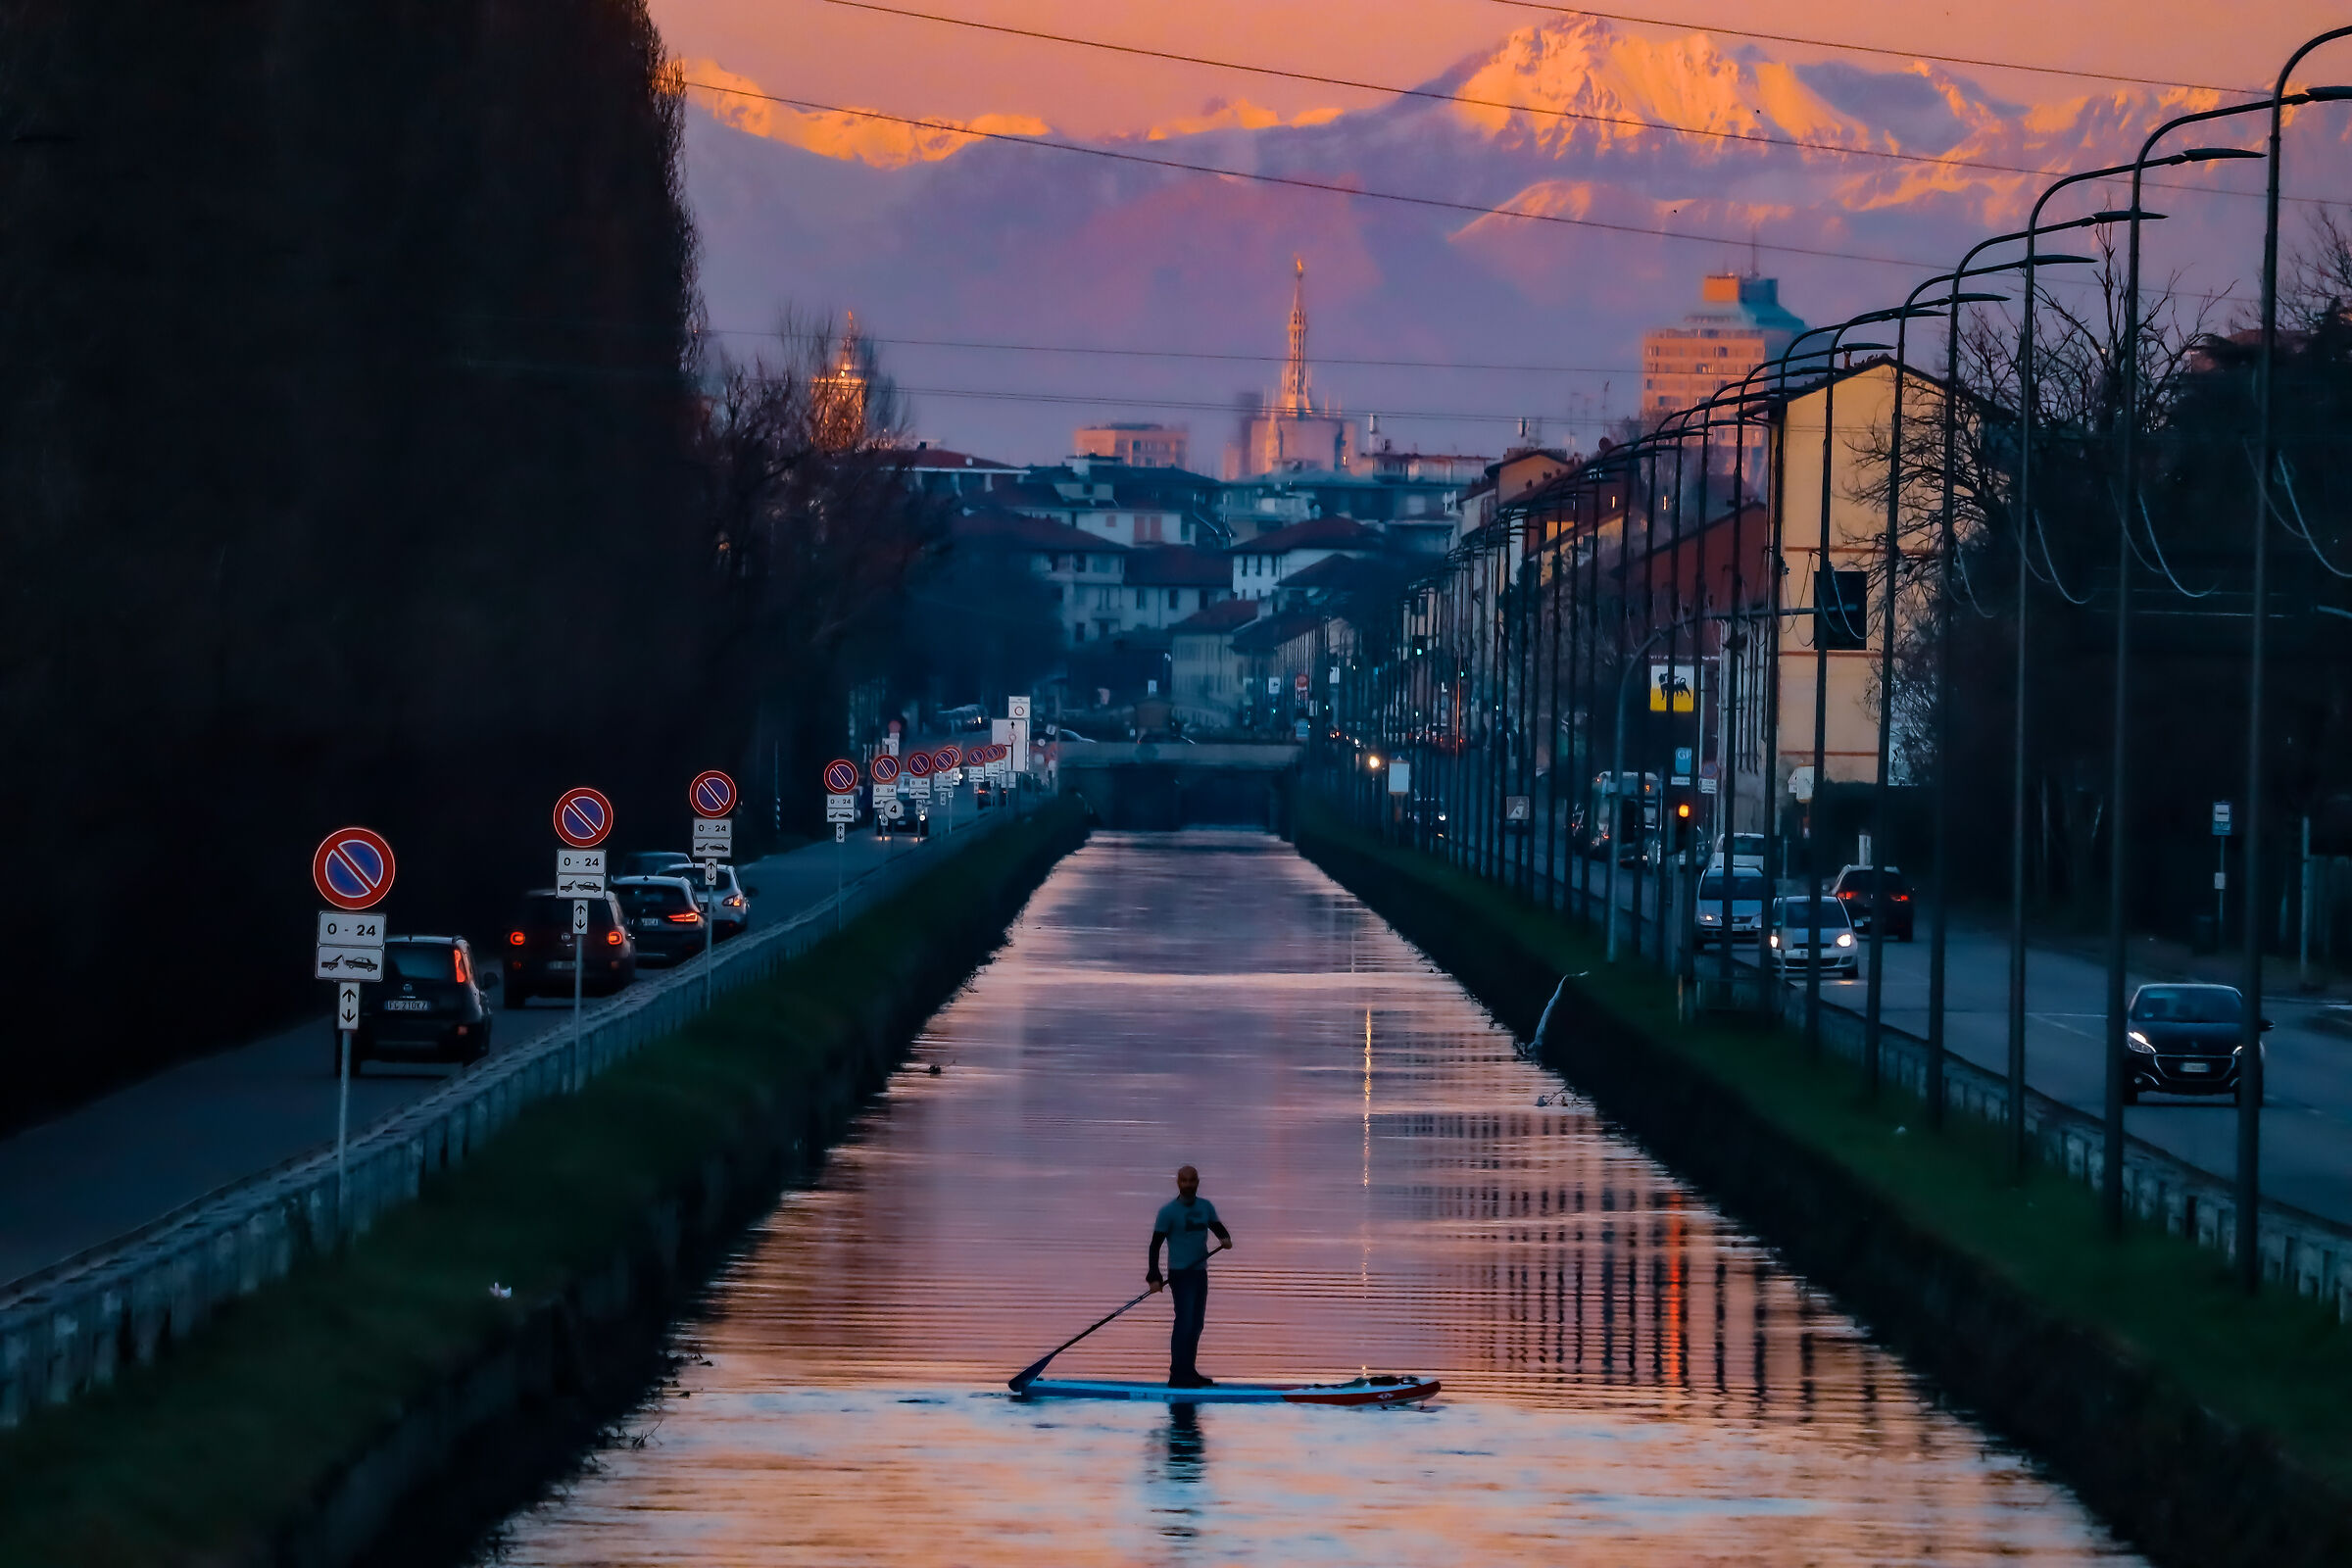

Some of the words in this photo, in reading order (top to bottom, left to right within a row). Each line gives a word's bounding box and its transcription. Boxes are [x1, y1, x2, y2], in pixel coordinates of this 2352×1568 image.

[889, 805, 898, 814] 4
[564, 857, 571, 867] 0
[584, 857, 600, 867] 24
[326, 922, 337, 935] 0
[356, 924, 376, 937] 24
